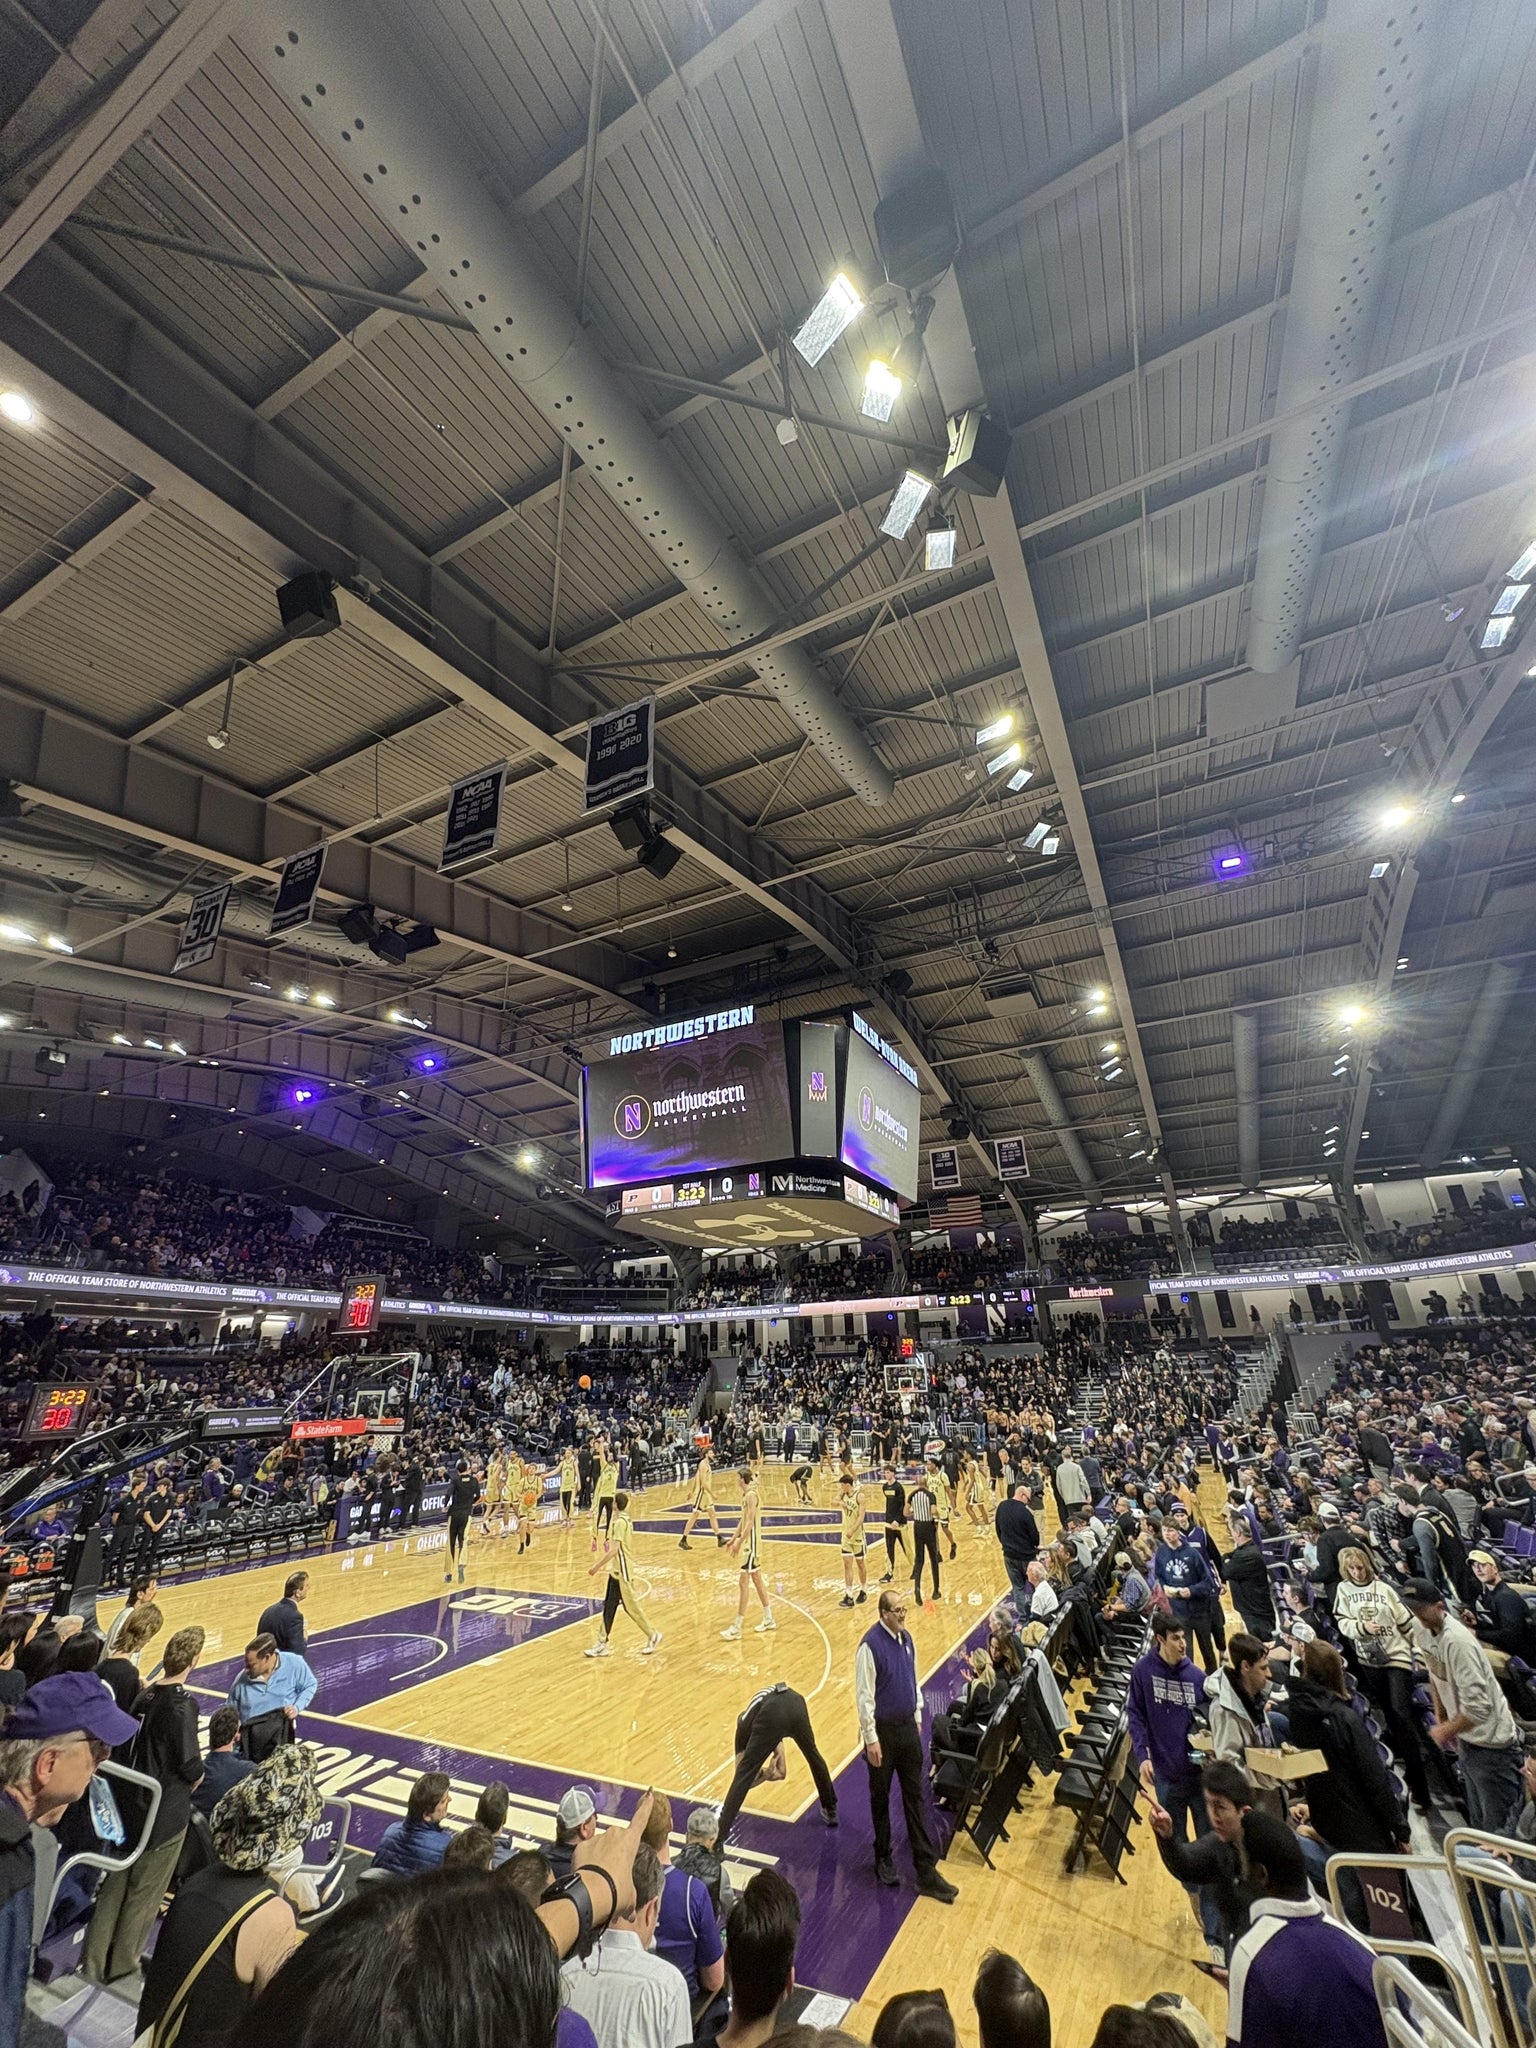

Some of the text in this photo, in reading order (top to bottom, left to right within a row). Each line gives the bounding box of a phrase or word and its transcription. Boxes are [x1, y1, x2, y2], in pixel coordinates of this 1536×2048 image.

[620, 733, 642, 750] 2020
[185, 904, 220, 945] 30
[610, 1005, 754, 1056] NORTHWESTERN
[652, 1084, 746, 1117] northwestern
[625, 1102, 641, 1132] N
[654, 1105, 747, 1128] BASKETBALL
[677, 1186, 706, 1201] 3:23
[722, 1177, 733, 1193] 0
[795, 1183, 826, 1193] Medicine
[1342, 1250, 1513, 1277] THE OFFICIAL TEAM STORE OF NORTHWESTERN ATHLETICS
[28, 1271, 227, 1295] THE OFFICIAL TEAM STORE OF NORTHWESTERN ATHLETICS
[1168, 1280, 1184, 1289] TEAM
[1184, 1279, 1203, 1288] STORE
[1211, 1276, 1258, 1286] NORTHWESTERN
[1259, 1274, 1289, 1283] ATHLETICS
[276, 1292, 340, 1304] THE OFFICIAL TEAM STORE
[355, 1284, 376, 1299] 3:23
[949, 1294, 971, 1305] 3:23
[1068, 1285, 1114, 1298] Northwestern
[347, 1301, 371, 1326] 30
[49, 1389, 87, 1406] 3:23
[41, 1407, 71, 1430] 30
[1347, 1592, 1387, 1606] PURDUE
[311, 1820, 333, 1842] 103
[1366, 1883, 1404, 1914] 102
